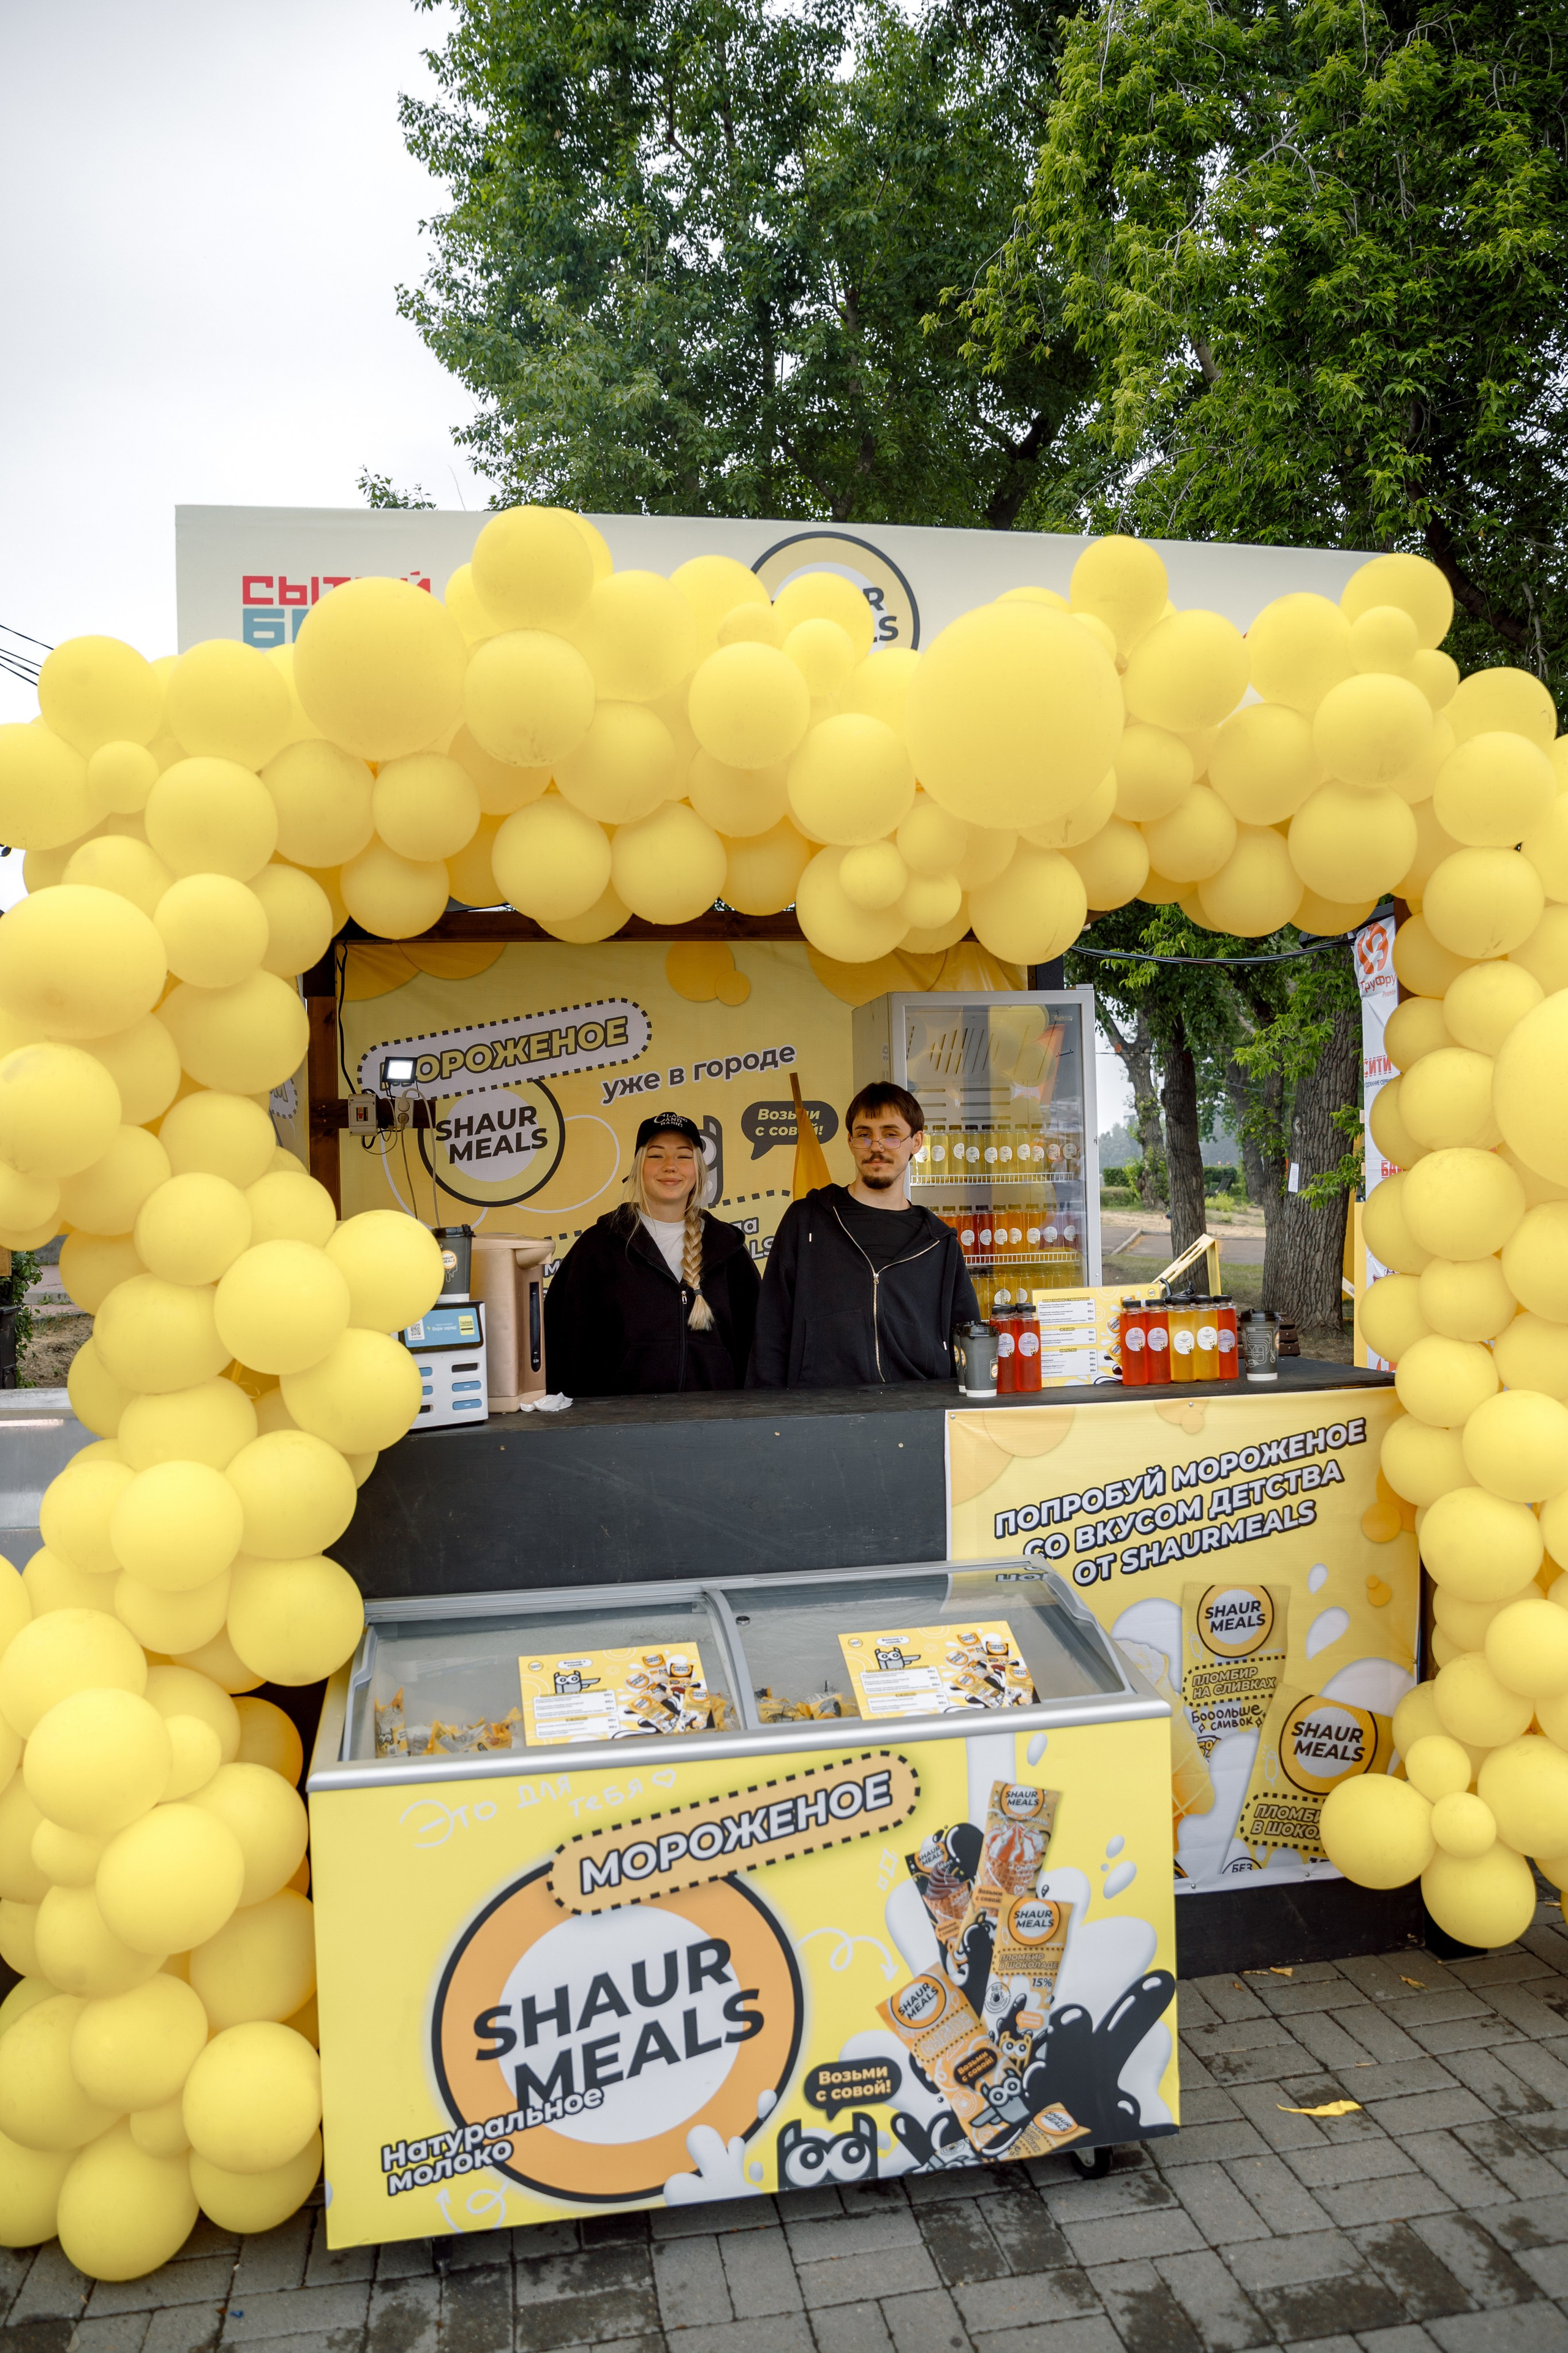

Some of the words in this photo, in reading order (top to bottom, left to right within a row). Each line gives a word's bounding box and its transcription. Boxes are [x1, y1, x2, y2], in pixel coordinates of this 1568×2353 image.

[380, 1016, 628, 1092] ОРОЖЕНОЕ
[603, 1073, 660, 1104] уже
[669, 1068, 684, 1086] в
[694, 1046, 795, 1081] городе
[435, 1106, 537, 1141] SHAUR
[758, 1109, 821, 1120] Возьи
[755, 1126, 764, 1136] с
[769, 1123, 823, 1136] совй!
[449, 1128, 548, 1164] MEALS
[995, 1467, 1166, 1538] ПОПРОБУЙ
[1172, 1418, 1366, 1490] МОРОЖЕНОЕ
[1023, 1533, 1069, 1560] СО
[1075, 1495, 1201, 1552] ВКУСОМ
[1208, 1460, 1345, 1518] ДЕТСТВА
[1073, 1554, 1117, 1586] ОТ
[1120, 1500, 1317, 1574] SHAURMEALS
[1205, 1600, 1262, 1619] SHAUR
[1210, 1613, 1266, 1633] MEALS
[1192, 1666, 1258, 1686] ПЛОМБИР
[1192, 1686, 1211, 1700] НА
[1213, 1677, 1276, 1696] СЛИВКАХ
[1291, 1721, 1363, 1743] SHAUR
[1293, 1740, 1366, 1762] MEALS
[1253, 1803, 1321, 1824] ПЛОМБ
[579, 1769, 892, 1895] МОРОЖЕНОЕ
[1250, 1821, 1264, 1835] В
[1264, 1822, 1321, 1840] ШОКО
[1014, 1909, 1052, 1919] SHAUR
[1016, 1919, 1054, 1928] MEALS
[998, 1962, 1005, 1971] В
[1006, 1962, 1058, 1970] ШОКОЛАДЕ
[999, 1952, 1044, 1962] ПЛОМБИР
[1031, 1977, 1053, 1988] 15%
[473, 1937, 733, 2061] SHAUR
[898, 1982, 930, 2015] SHAUR
[907, 1986, 939, 2020] MEALS
[513, 1988, 764, 2111] MEALS
[957, 2051, 989, 2075] Возьми
[818, 2066, 888, 2087] Возьми
[815, 2089, 827, 2103] с
[831, 2079, 892, 2100] совой!
[381, 2087, 604, 2172] Натуральное
[387, 2139, 514, 2196] молоко
